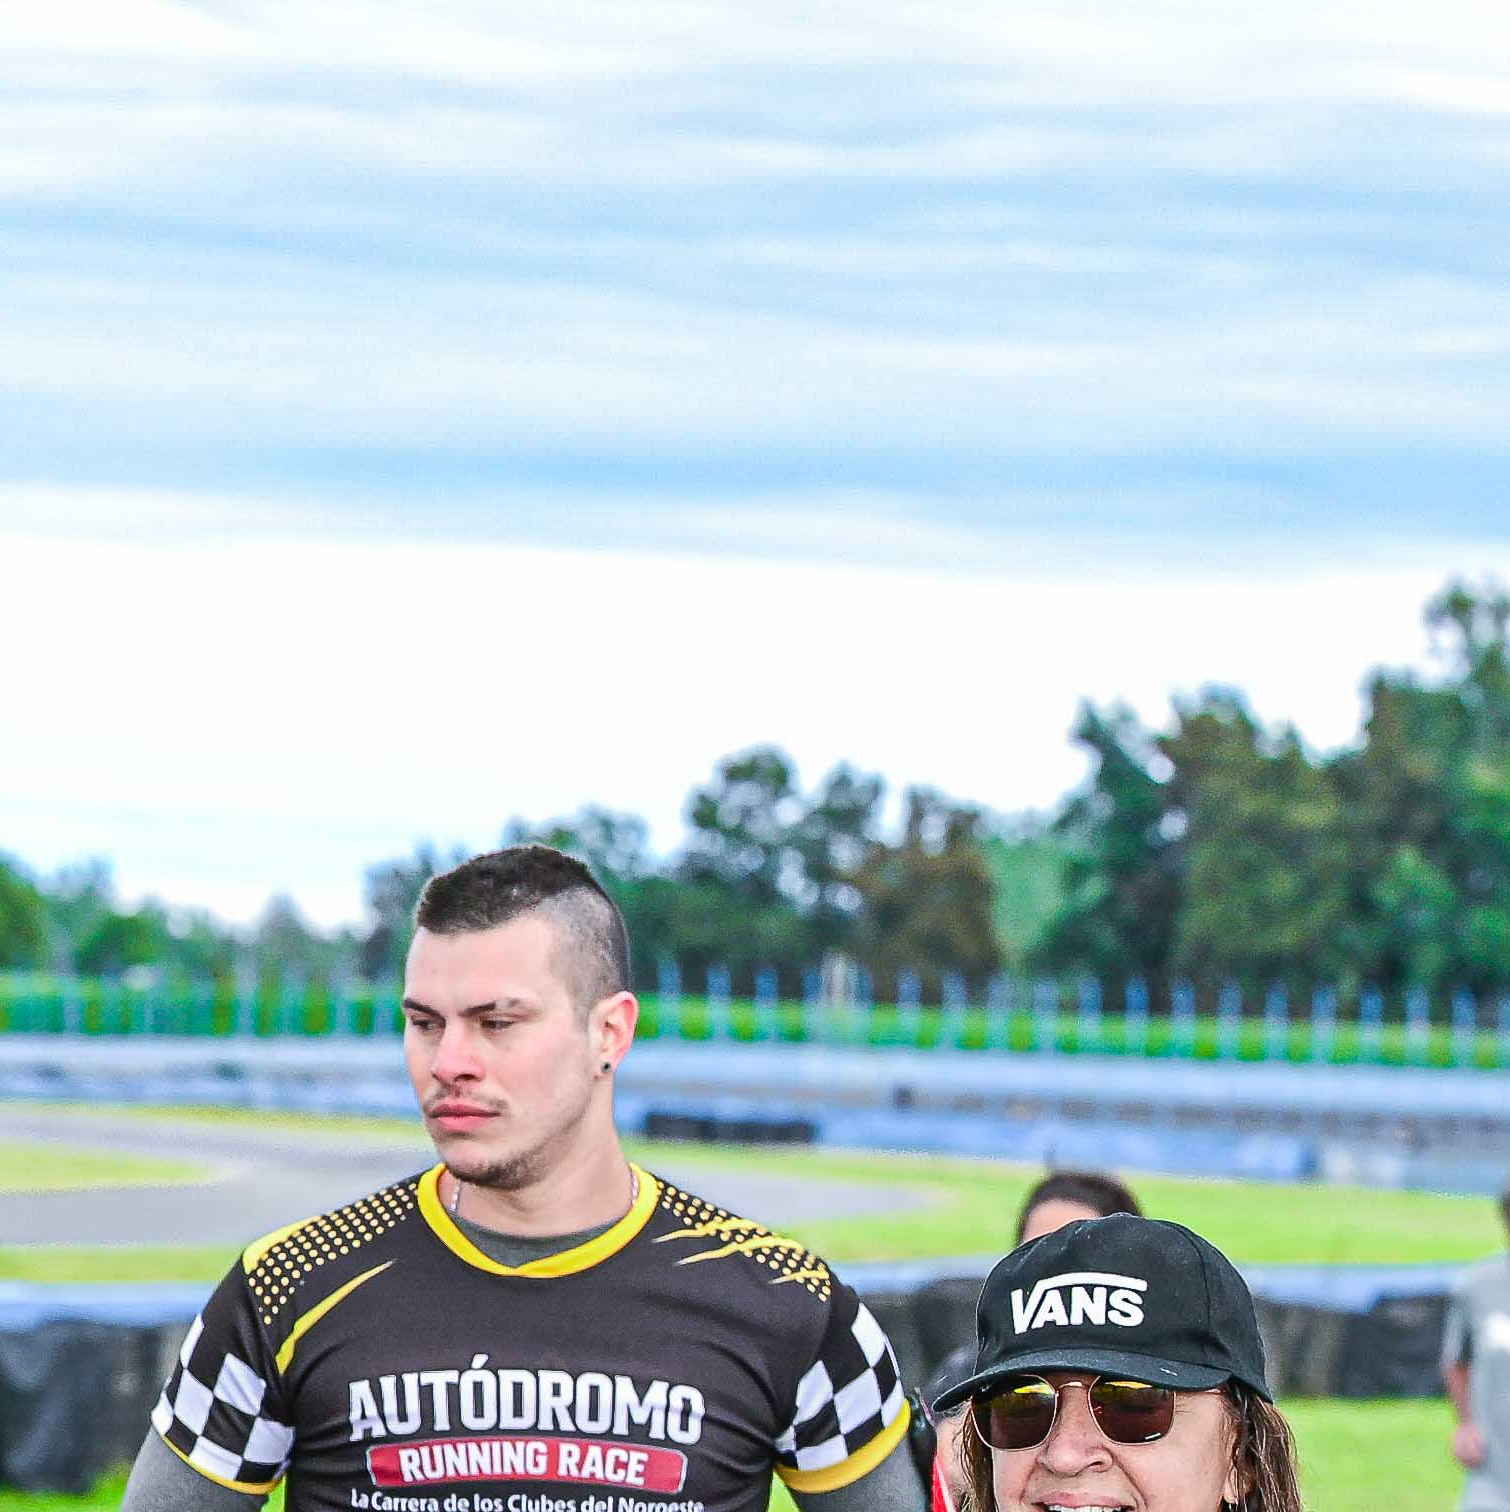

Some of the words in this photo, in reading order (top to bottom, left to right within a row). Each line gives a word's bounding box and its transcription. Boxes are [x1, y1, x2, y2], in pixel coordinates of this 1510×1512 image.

[1010, 1271, 1148, 1335] VANS
[348, 1353, 706, 1445] AUTÓDROMO
[397, 1440, 549, 1483] RUNNING
[557, 1446, 649, 1486] RACE
[350, 1488, 369, 1510] La
[371, 1491, 439, 1512] Carrera
